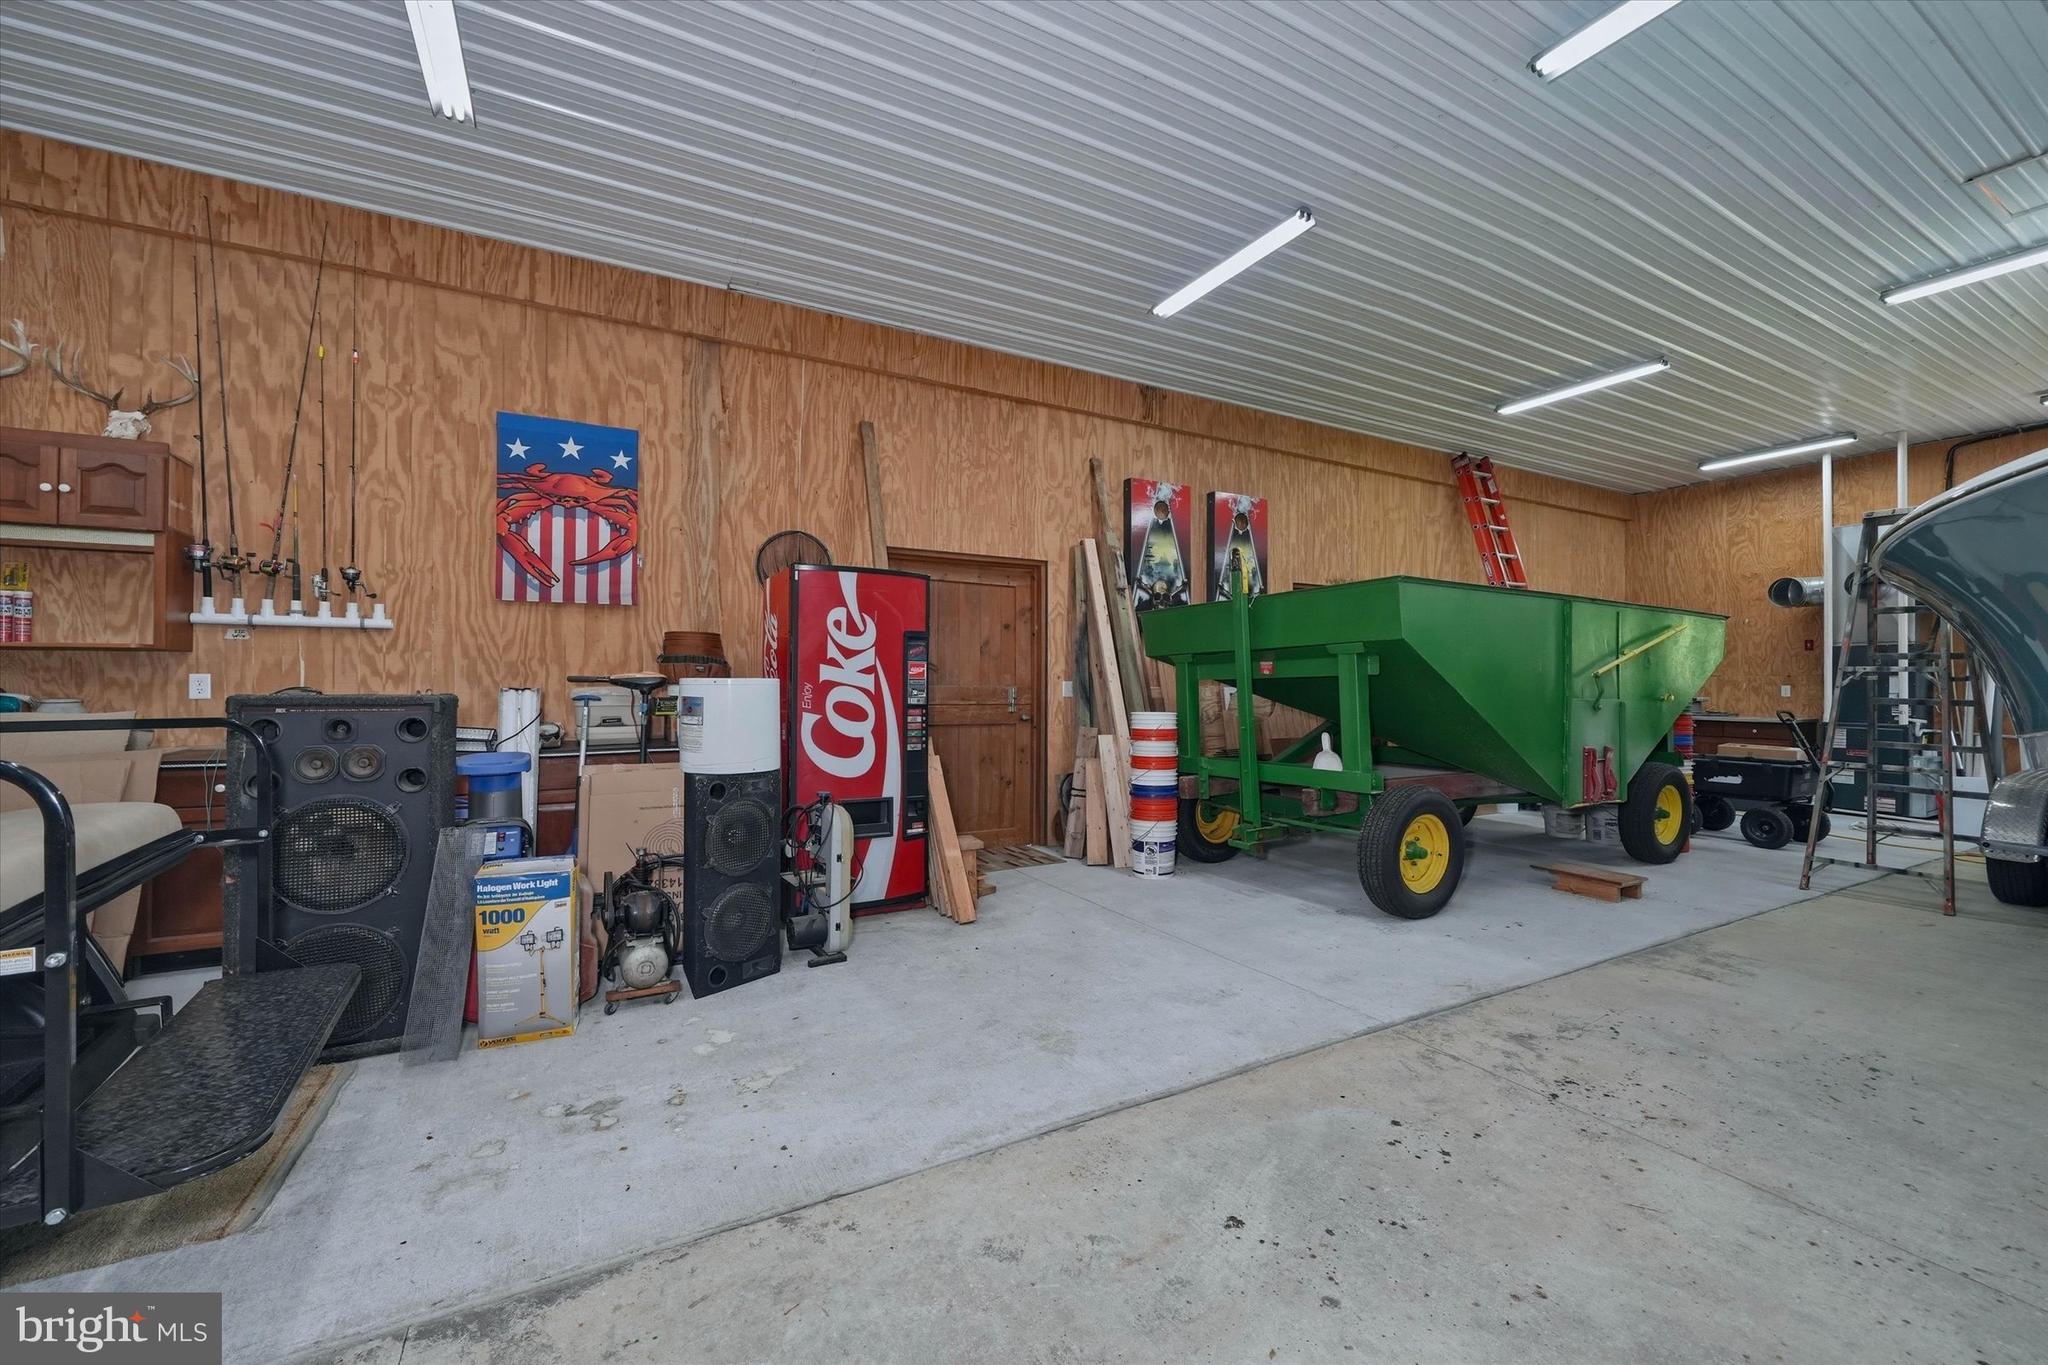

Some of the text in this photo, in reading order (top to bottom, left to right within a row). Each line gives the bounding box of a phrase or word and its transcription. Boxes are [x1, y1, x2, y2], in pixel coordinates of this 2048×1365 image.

[801, 607, 877, 778] Coke
[802, 682, 814, 709] Enjoy
[477, 878, 559, 893] Halogen Work Light
[479, 907, 526, 926] 1000
[482, 927, 500, 935] watt
